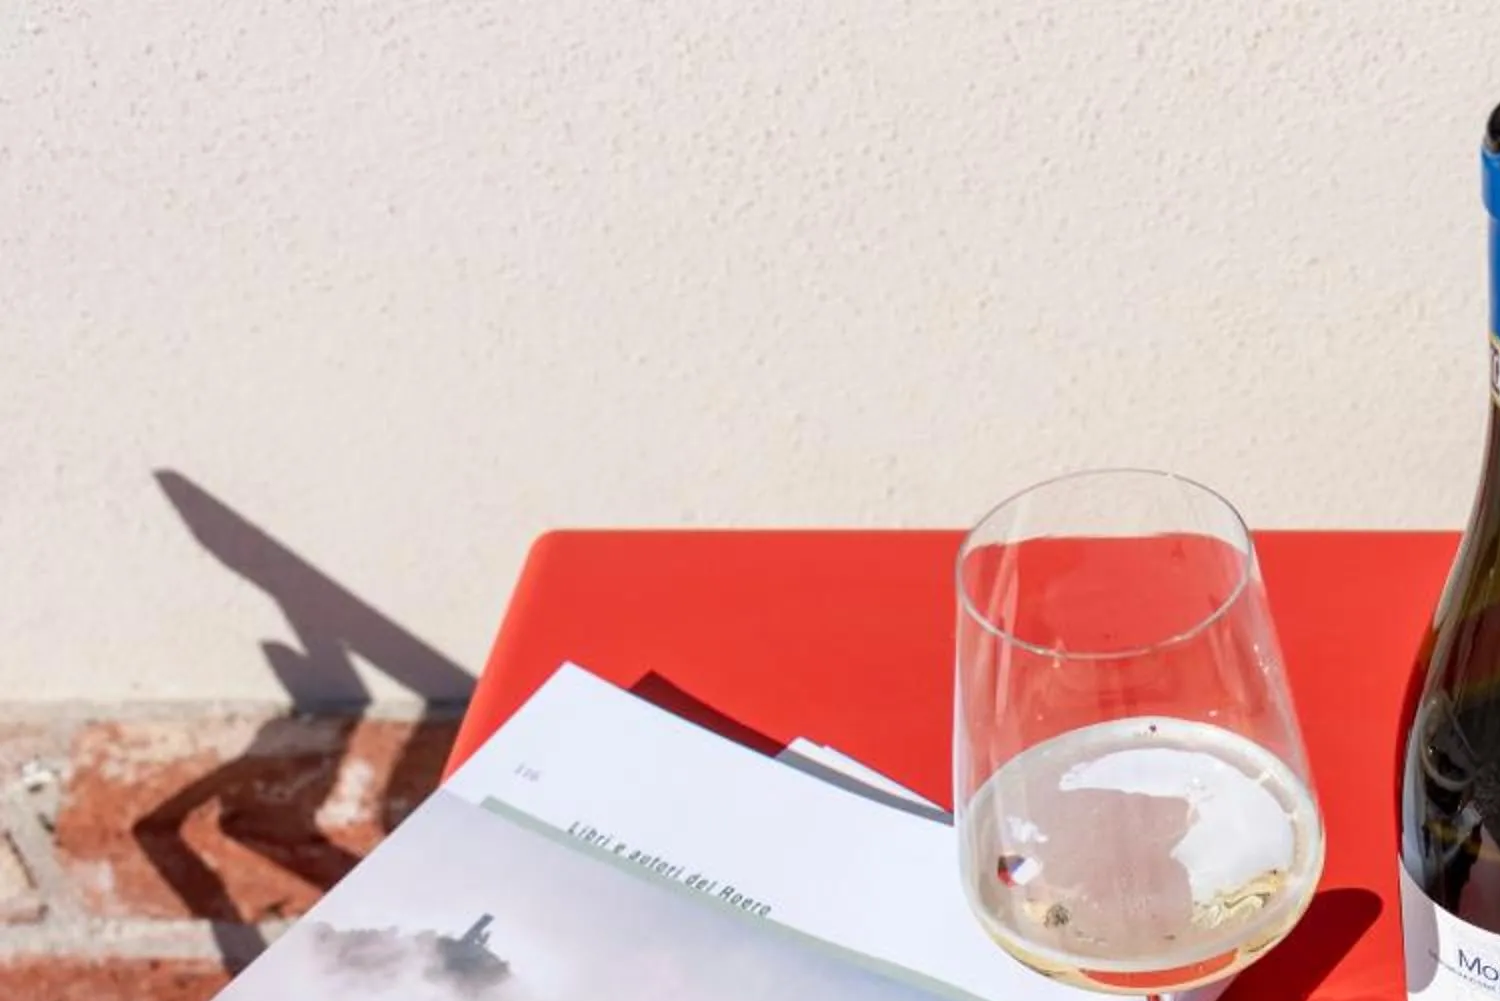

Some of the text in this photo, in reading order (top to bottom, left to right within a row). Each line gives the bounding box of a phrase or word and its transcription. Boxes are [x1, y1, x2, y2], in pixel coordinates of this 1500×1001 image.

[567, 820, 773, 918] Libri e autori del Roero
